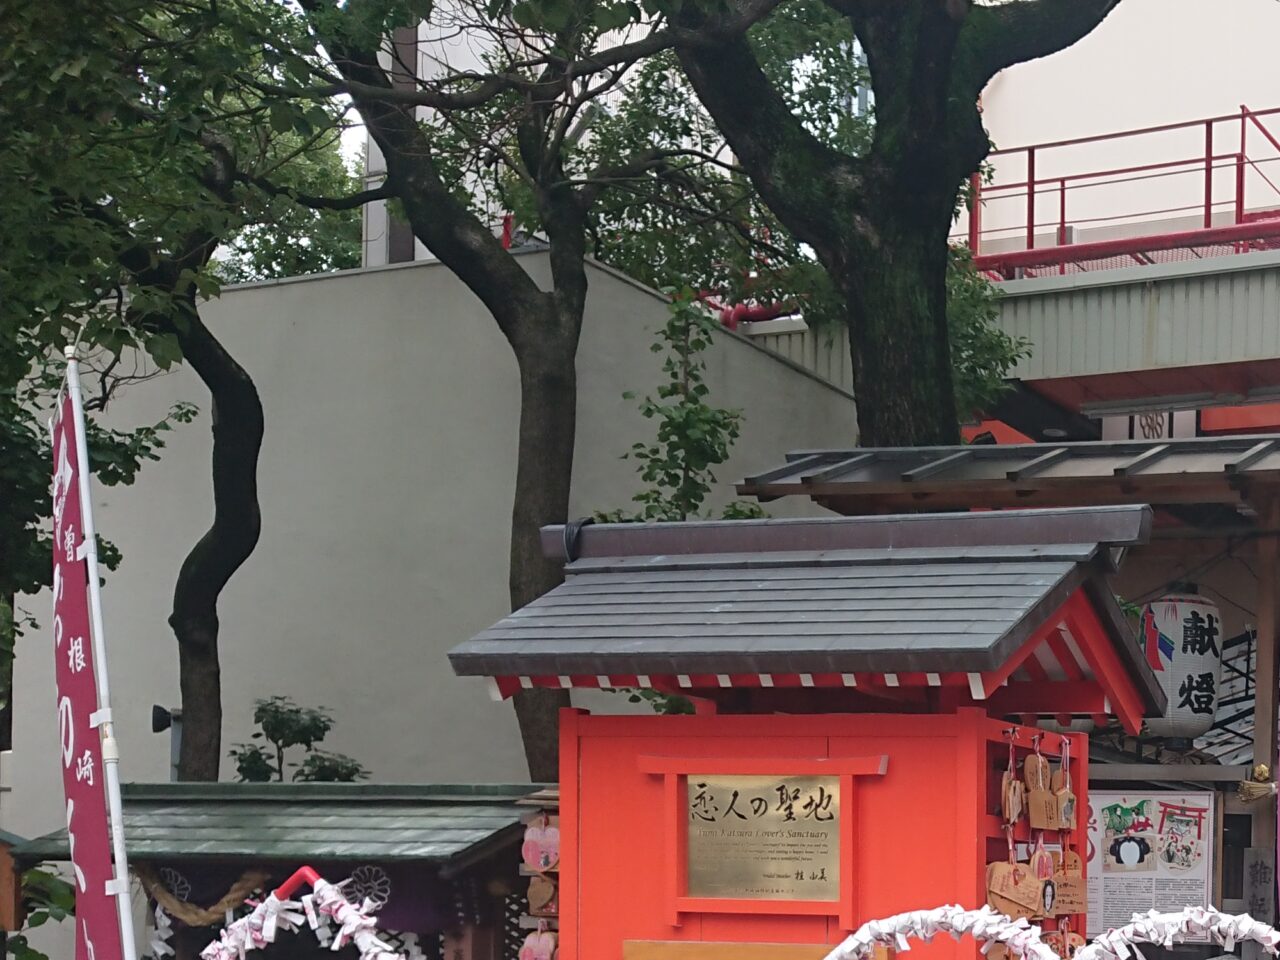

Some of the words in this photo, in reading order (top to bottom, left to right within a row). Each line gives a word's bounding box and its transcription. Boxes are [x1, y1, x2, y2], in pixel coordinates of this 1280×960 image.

[691, 783, 835, 822] 恋人の聖地
[786, 828, 829, 840] Sanctuary
